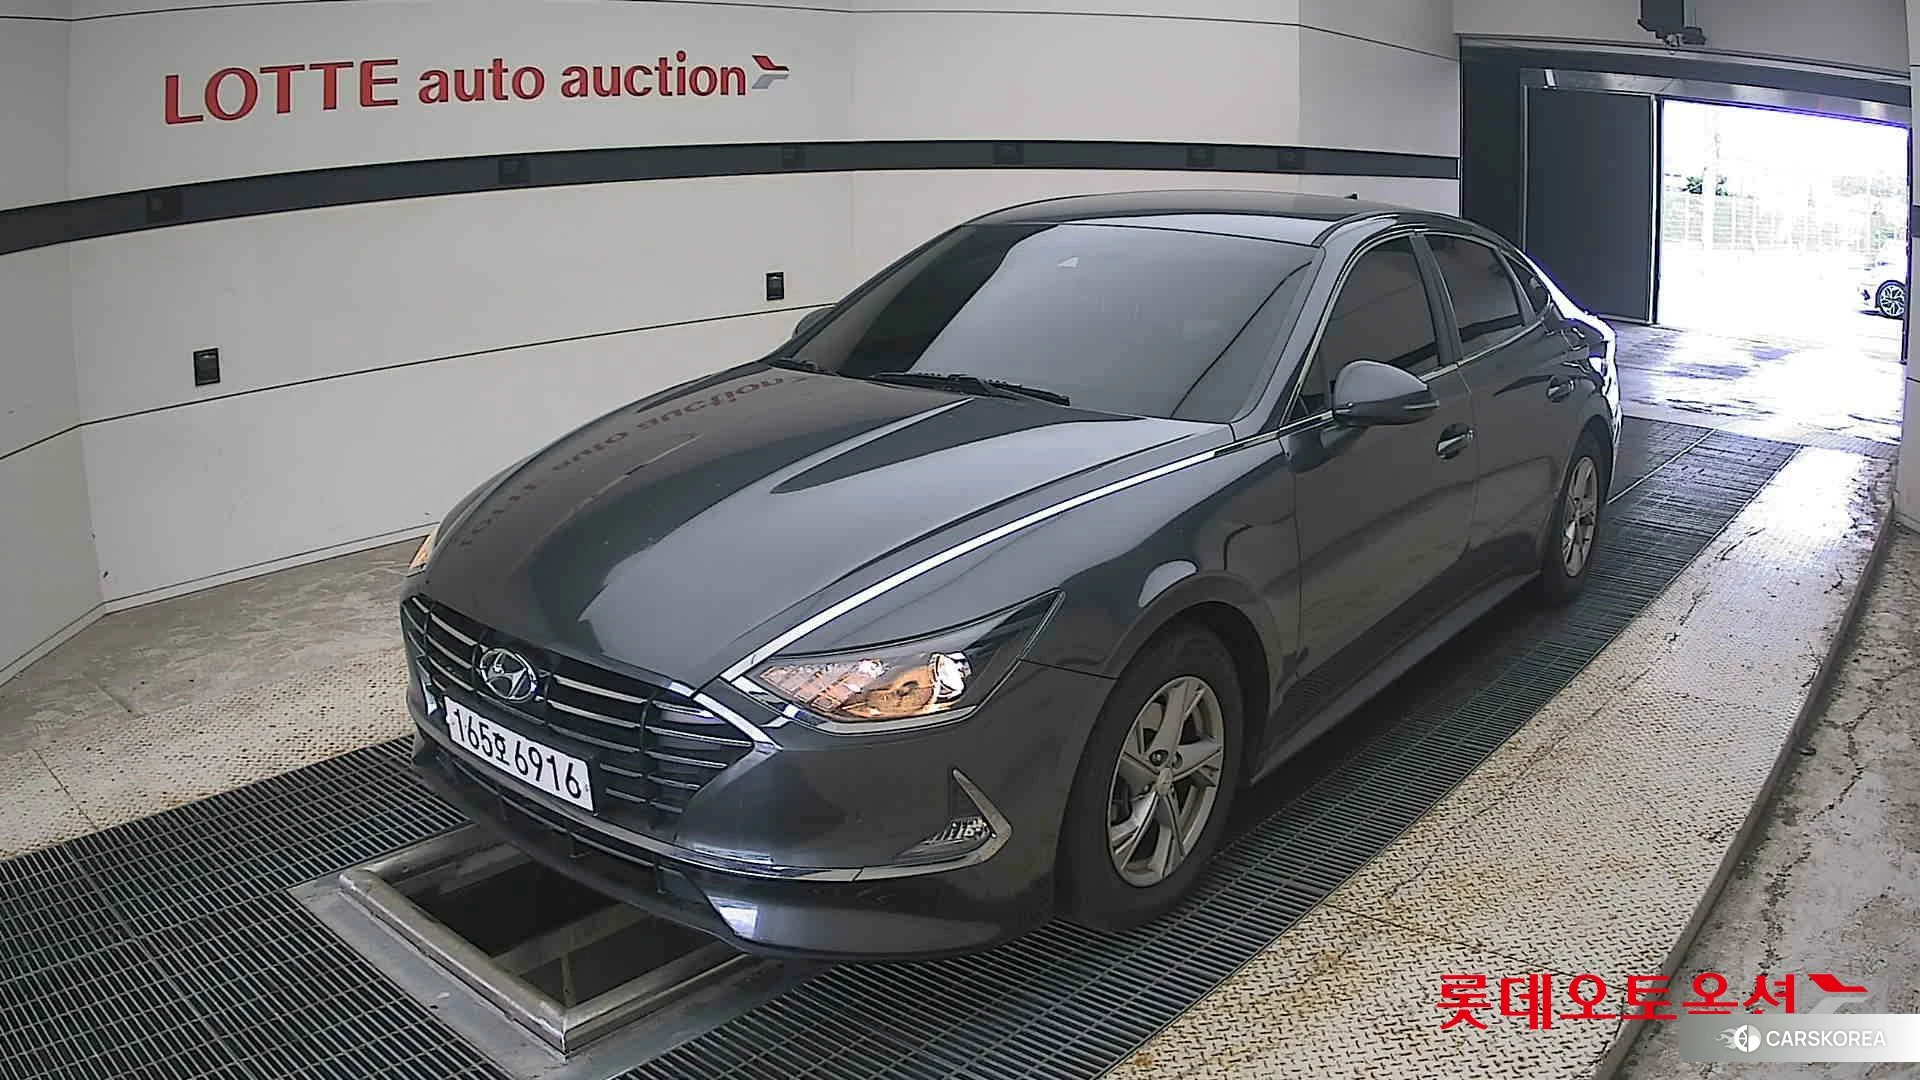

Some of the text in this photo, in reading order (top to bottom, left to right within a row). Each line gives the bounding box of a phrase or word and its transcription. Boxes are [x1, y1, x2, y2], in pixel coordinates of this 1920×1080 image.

[165, 49, 748, 125] LOTTE auto auction
